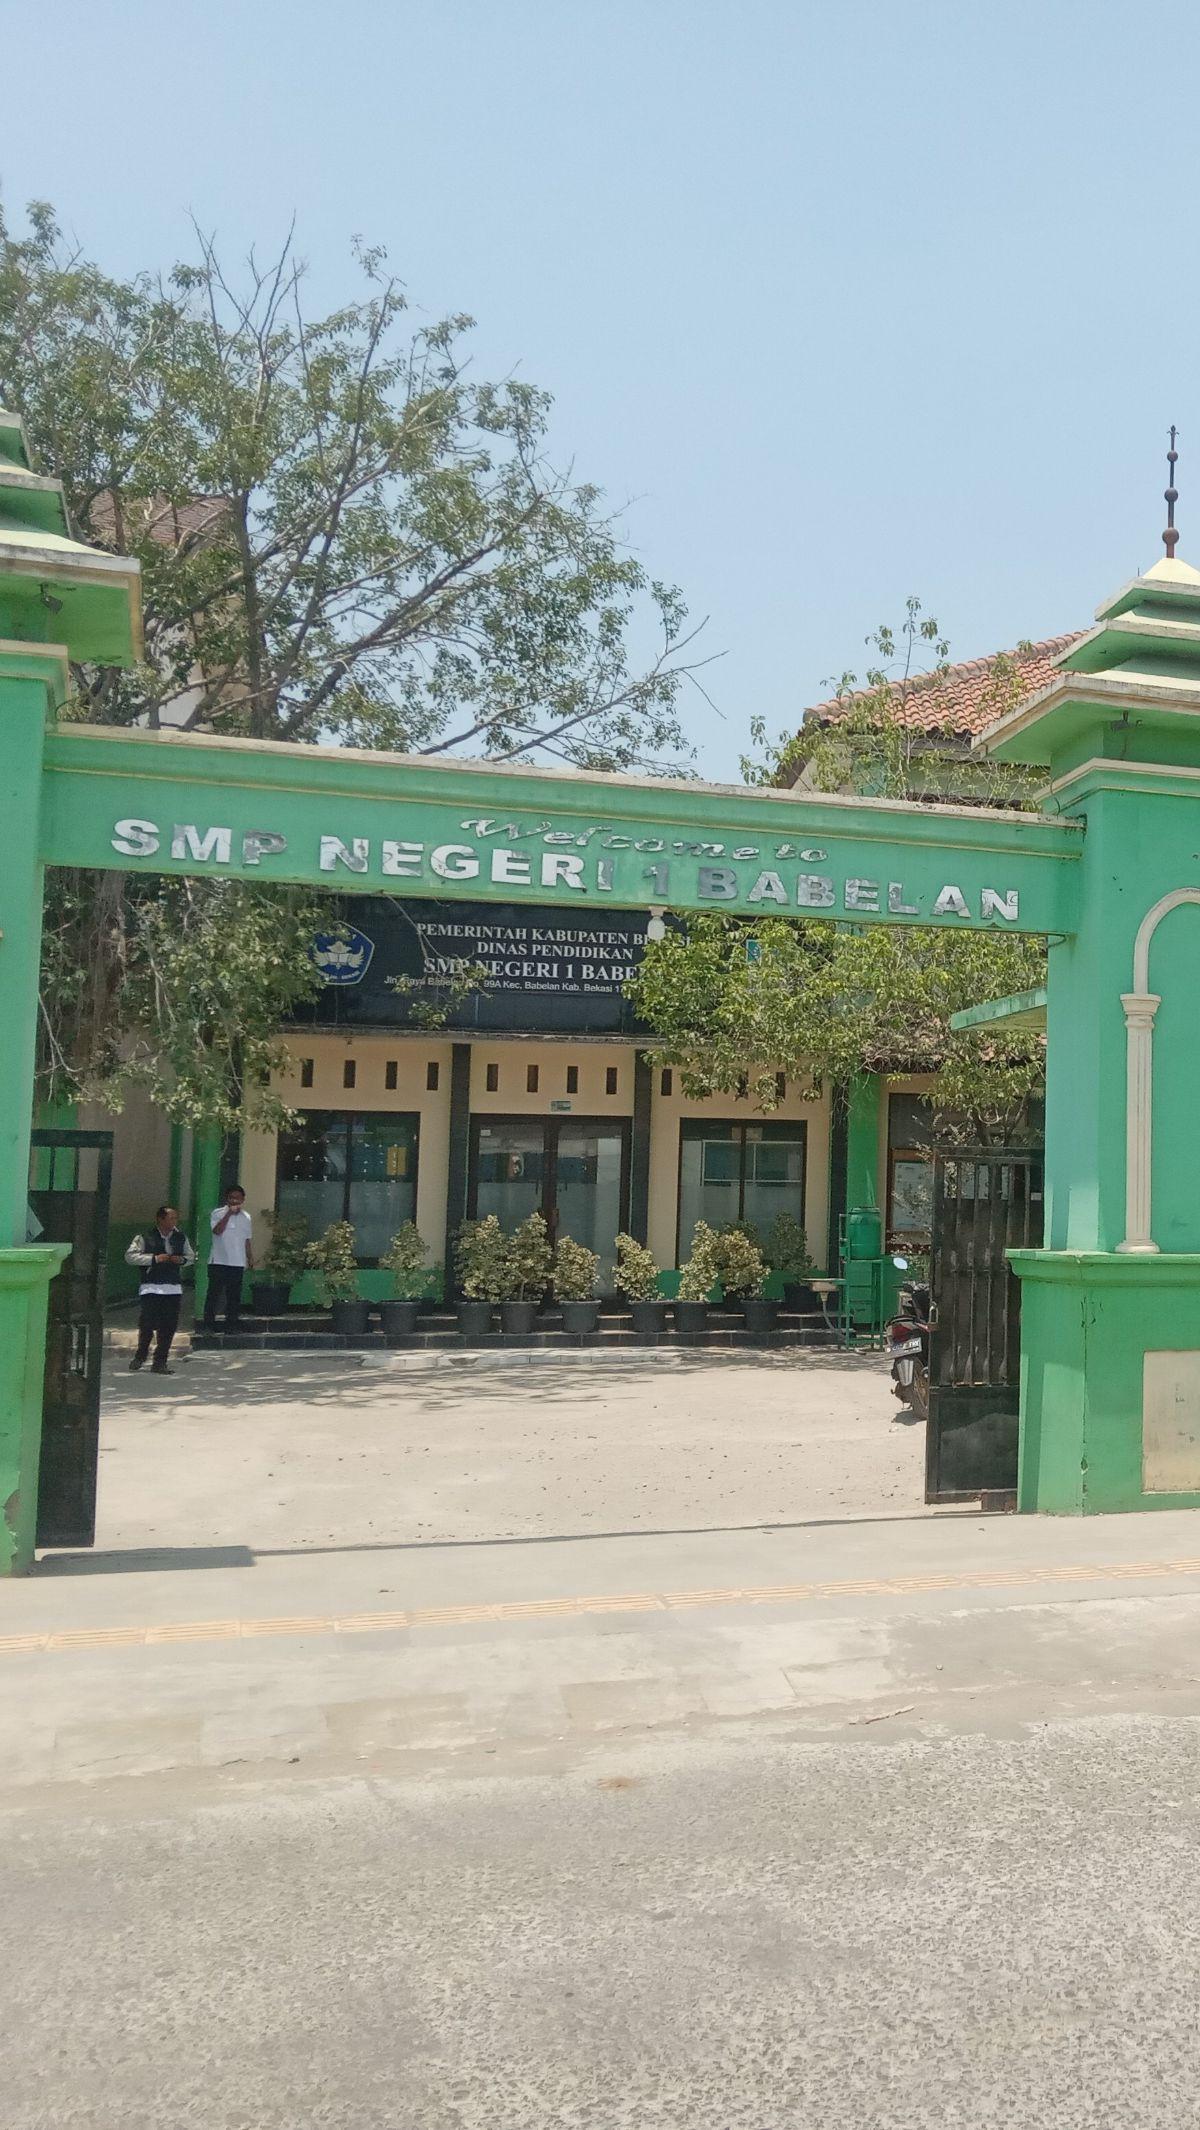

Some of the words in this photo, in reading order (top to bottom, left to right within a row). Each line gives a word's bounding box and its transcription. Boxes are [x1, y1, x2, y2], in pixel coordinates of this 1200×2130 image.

[460, 819, 759, 860] Welcome
[774, 843, 828, 862] to
[111, 819, 287, 867] SMP
[320, 835, 613, 893] NEGERI
[643, 861, 669, 896] 1
[698, 866, 1019, 921] BABELAN
[416, 923, 527, 940] PEMERINTAH
[532, 928, 629, 945] KABUPATEN
[477, 941, 528, 955] DINAS
[532, 944, 634, 960] PENDIDIKAN
[424, 958, 470, 974] SMP
[475, 960, 559, 978] NEGERI
[566, 964, 573, 979] 1
[582, 964, 637, 981] BABE
[524, 981, 560, 990] Babelan
[562, 983, 581, 992] Kab.
[584, 984, 612, 993] Bekasi
